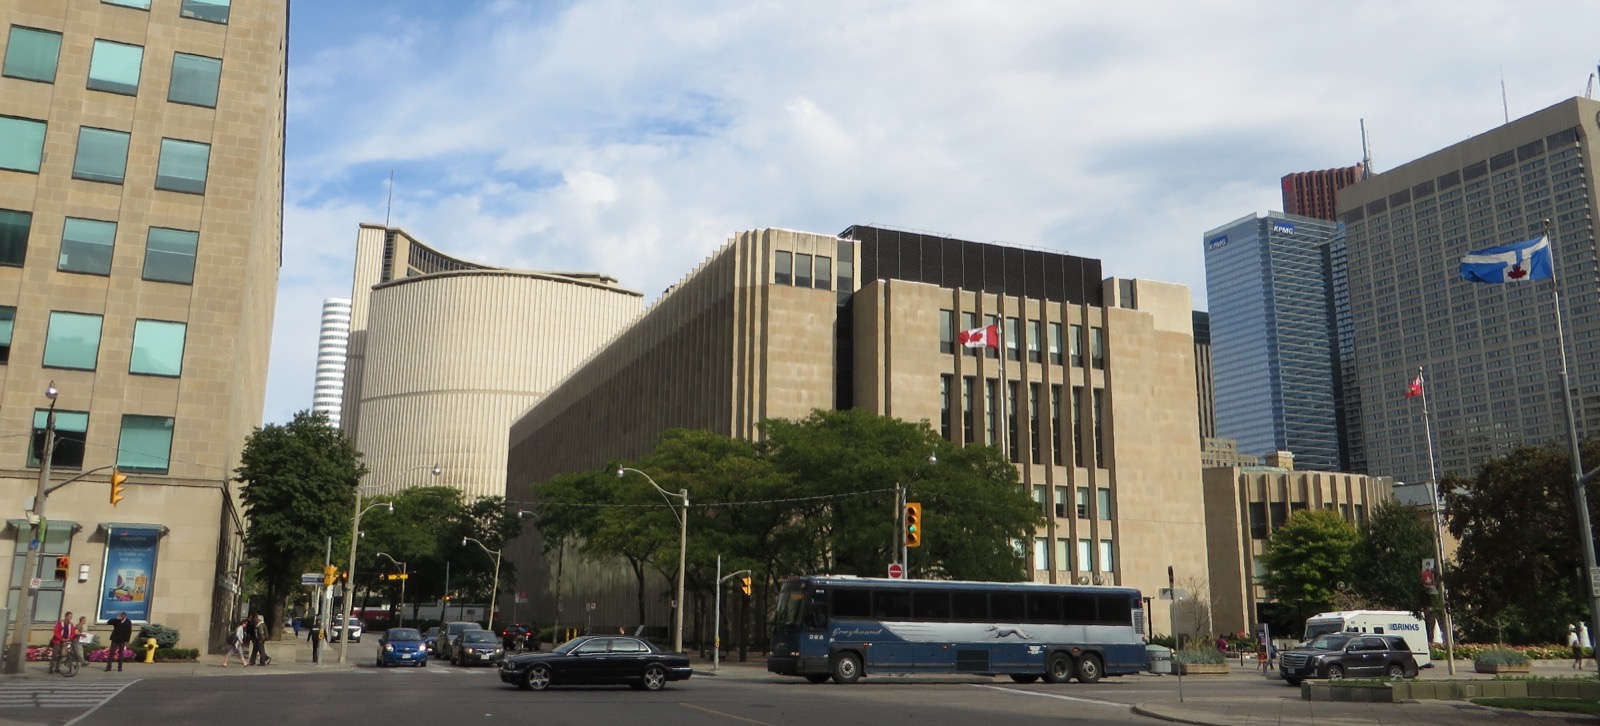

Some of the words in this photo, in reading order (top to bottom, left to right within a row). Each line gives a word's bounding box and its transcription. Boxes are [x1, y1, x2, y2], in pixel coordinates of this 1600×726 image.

[1273, 225, 1294, 235] KPMG
[832, 627, 883, 637] Greyhound
[1392, 623, 1420, 631] BRINKS
